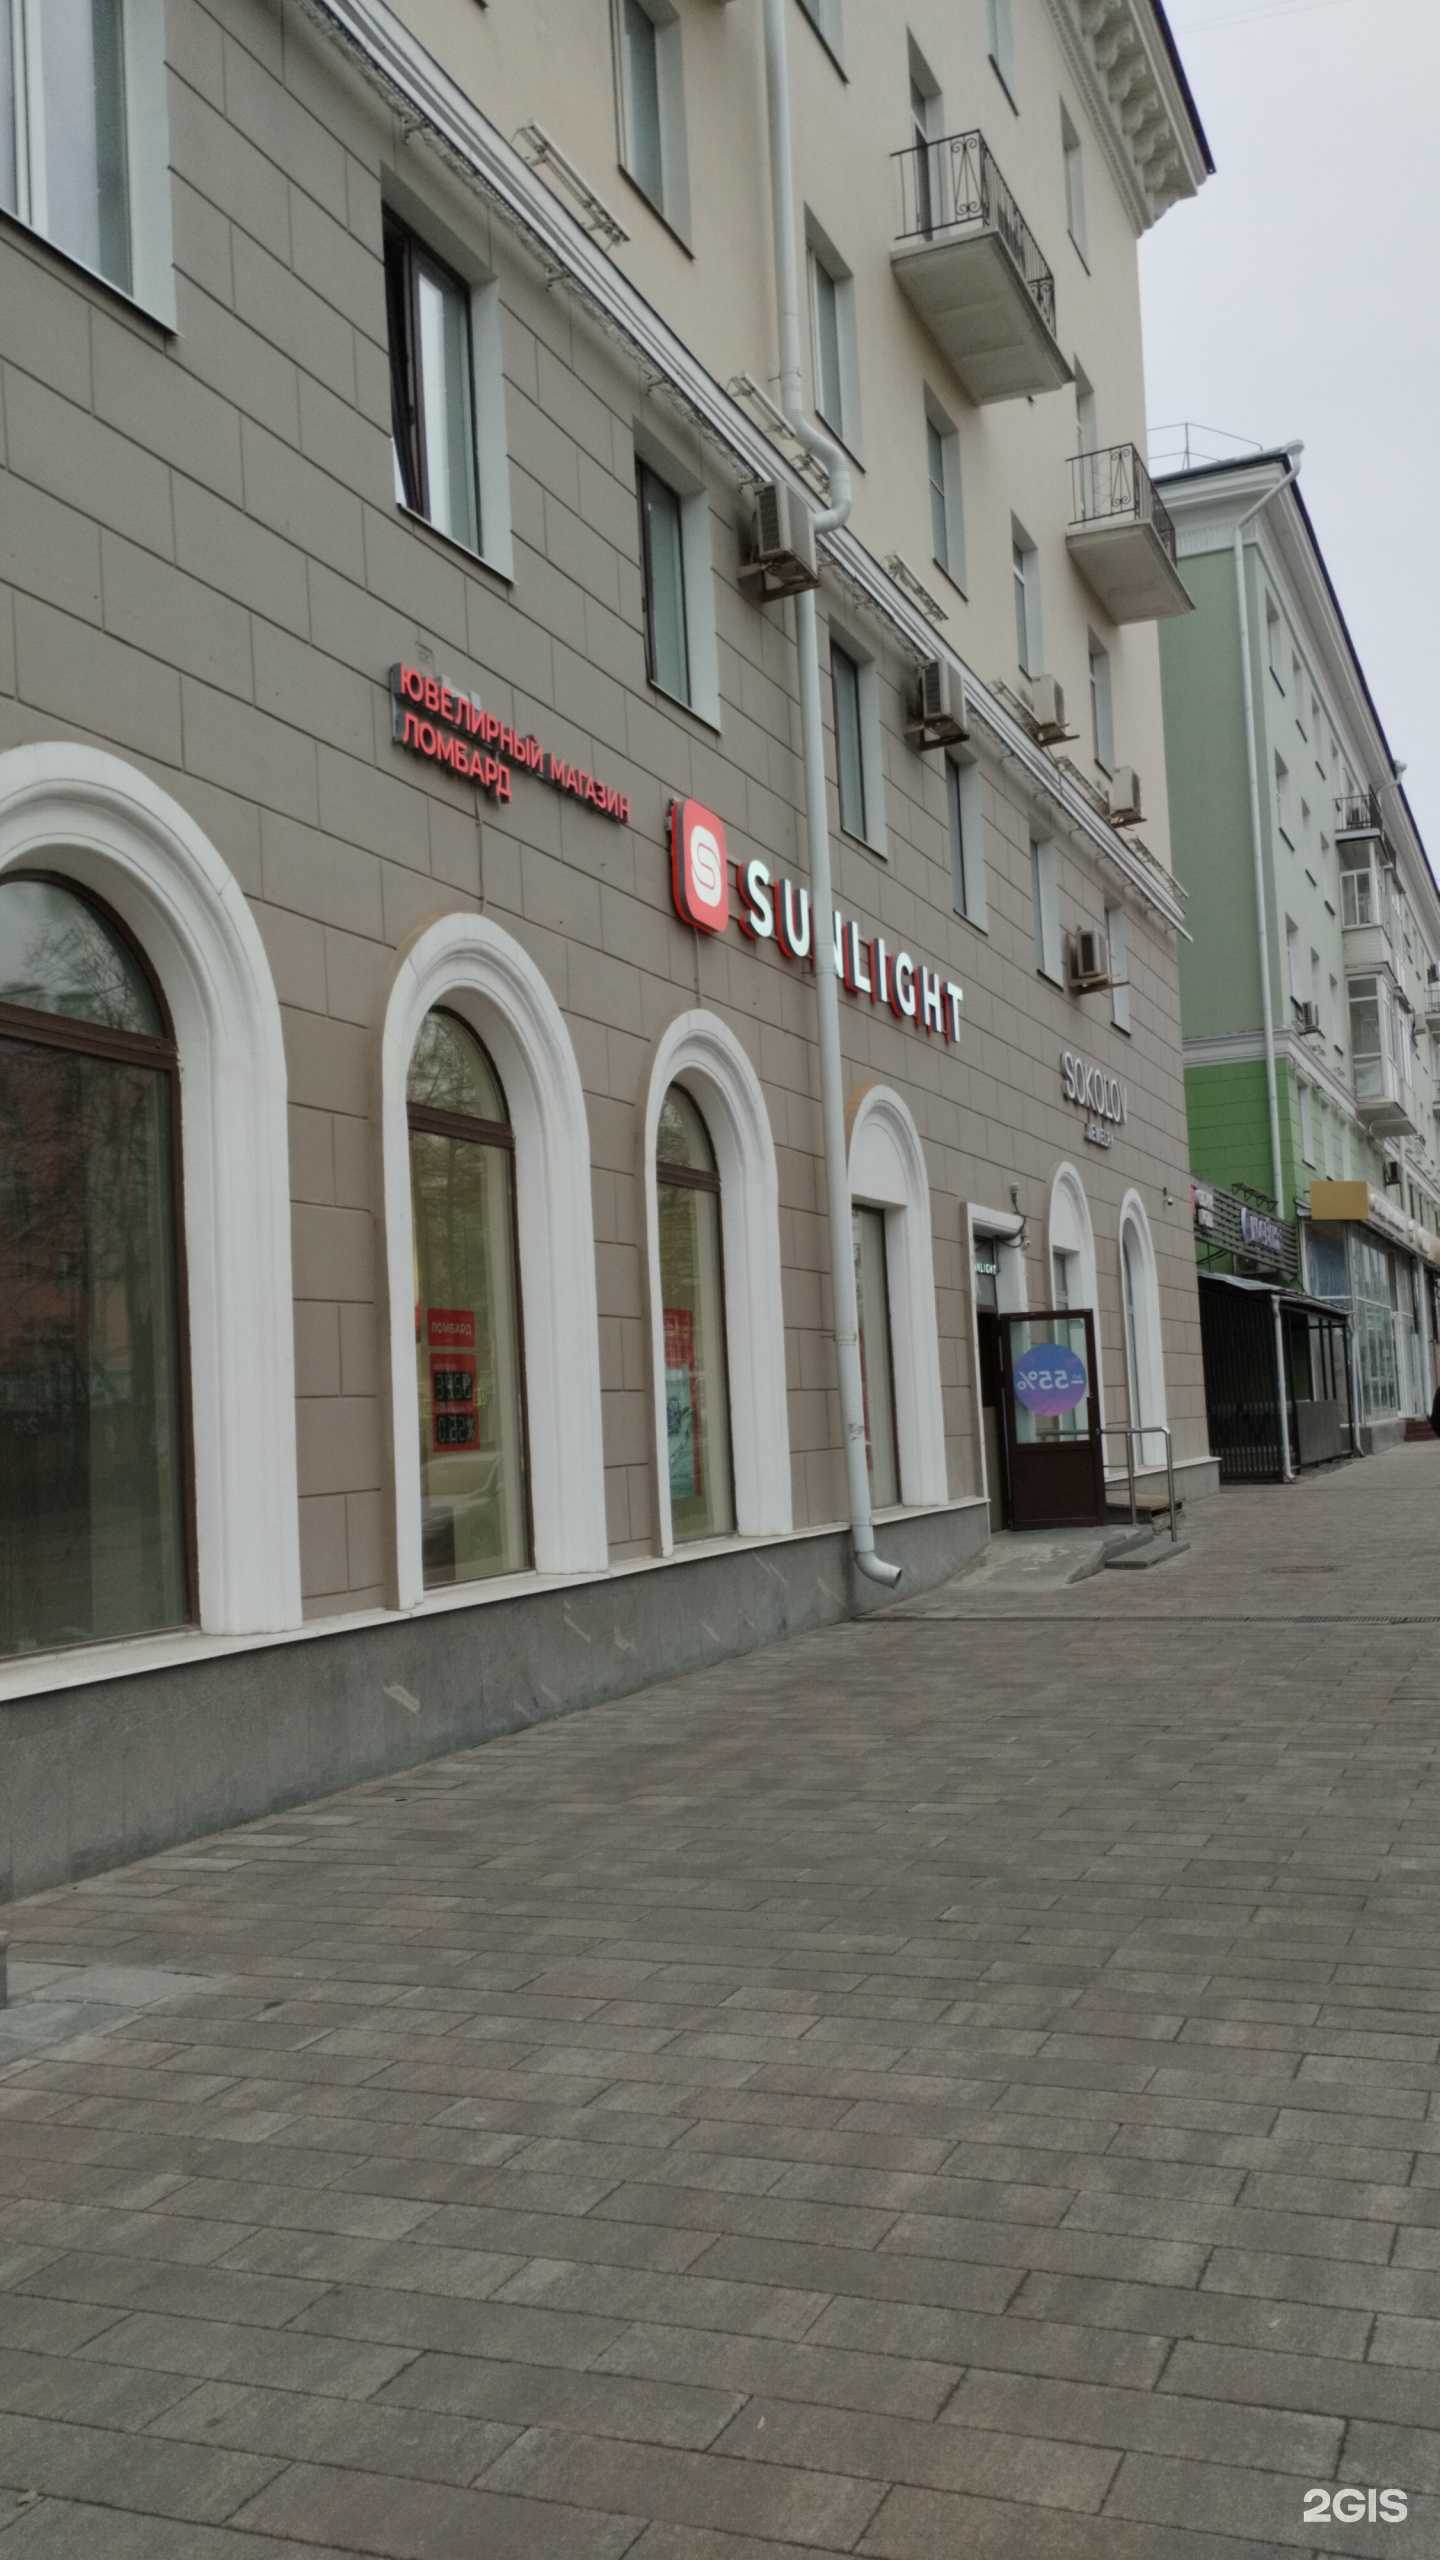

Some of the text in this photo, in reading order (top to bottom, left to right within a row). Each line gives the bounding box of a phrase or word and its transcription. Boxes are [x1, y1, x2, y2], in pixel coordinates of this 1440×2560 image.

[401, 662, 630, 823] ЮВЕЛИРНЫЙ МАГАЗИН
[402, 712, 512, 807] ЛОМБАРД
[1063, 1051, 1128, 1124] SOKOLOV
